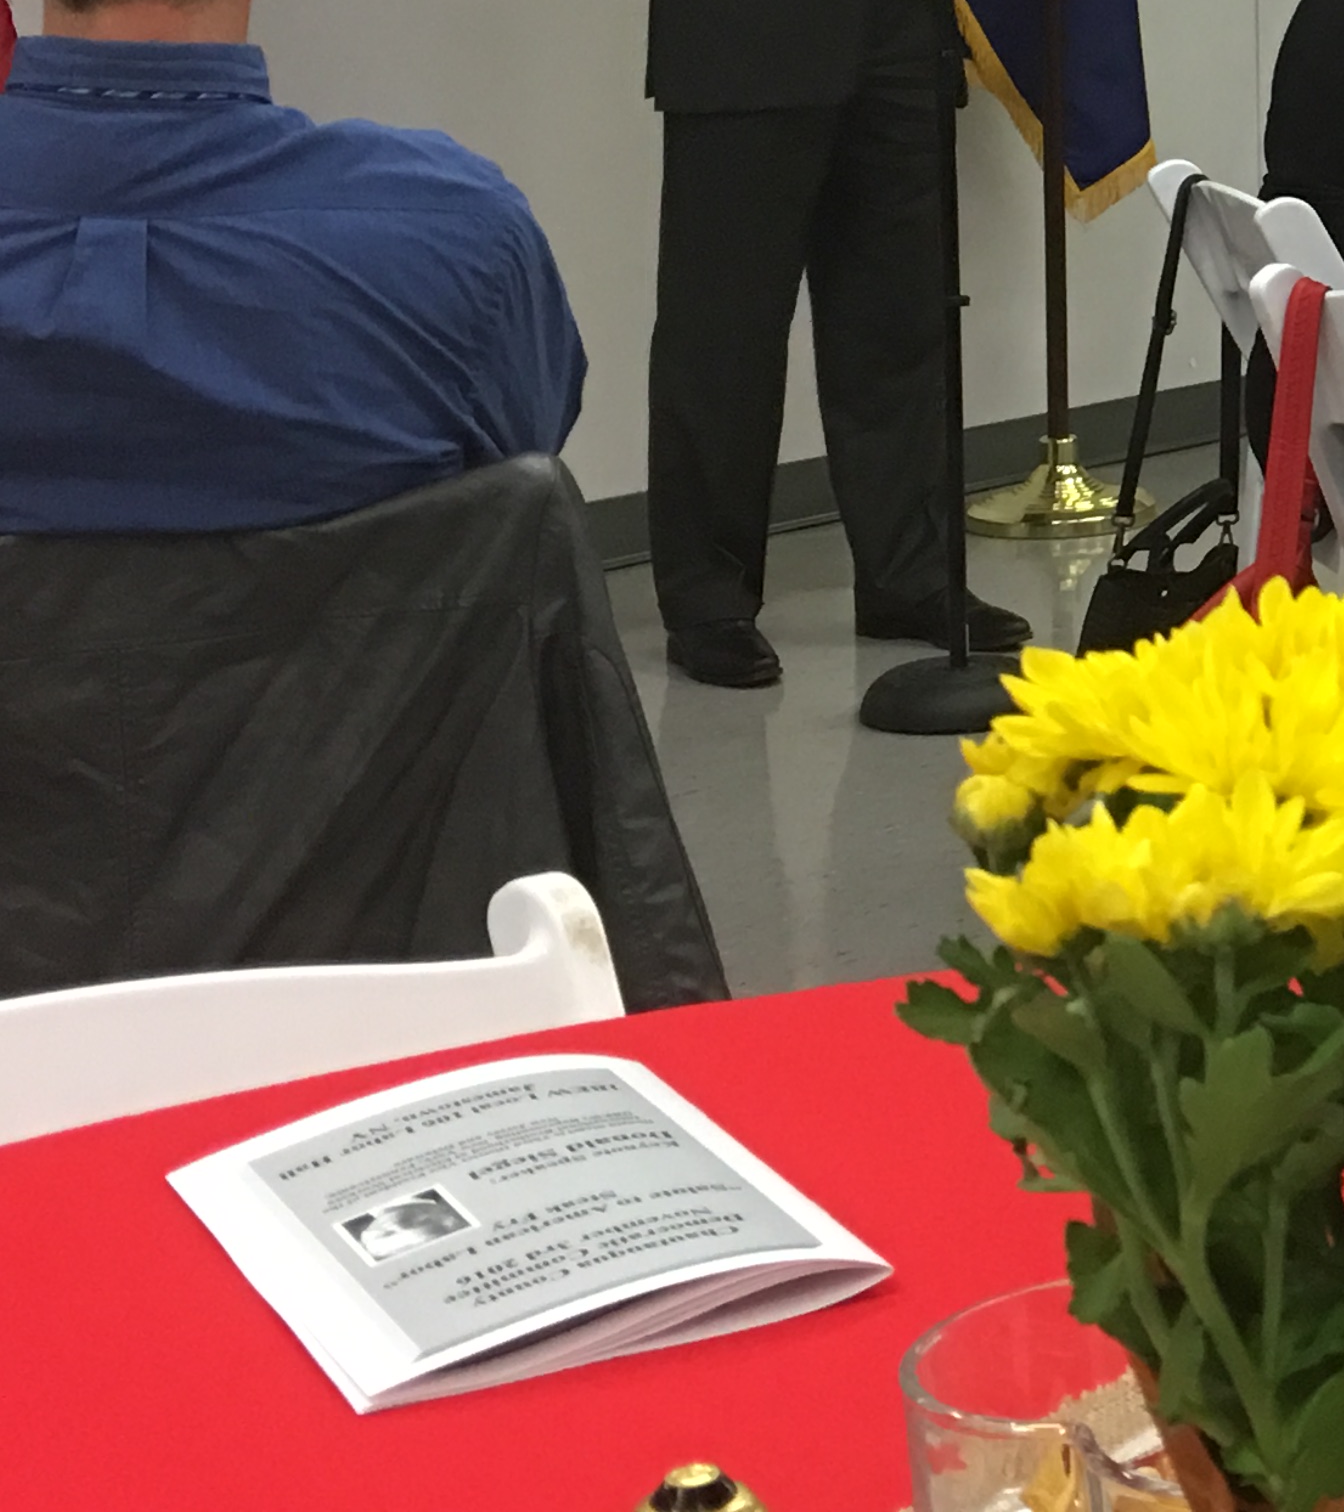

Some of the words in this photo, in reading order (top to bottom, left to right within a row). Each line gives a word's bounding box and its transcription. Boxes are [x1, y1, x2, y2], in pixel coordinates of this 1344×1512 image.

[471, 1093, 538, 1114] Local
[421, 1110, 462, 1128] 106
[339, 1125, 415, 1157] Labor
[350, 1123, 389, 1143] NY
[565, 1130, 672, 1153] Donald
[592, 1140, 680, 1158] Keynote
[278, 1155, 332, 1181] Hall
[467, 1148, 558, 1181] Siegel
[545, 1190, 617, 1214] Steak
[617, 1196, 642, 1207] to
[485, 1204, 607, 1247] American
[492, 1211, 536, 1232] Fry
[581, 1207, 712, 1243] November
[598, 1214, 744, 1250] Democratic
[525, 1240, 571, 1262] 3rd
[577, 1226, 739, 1269] Chautauqua
[444, 1249, 589, 1305] Committee
[455, 1258, 519, 1285] 2016
[474, 1269, 571, 1307] County
